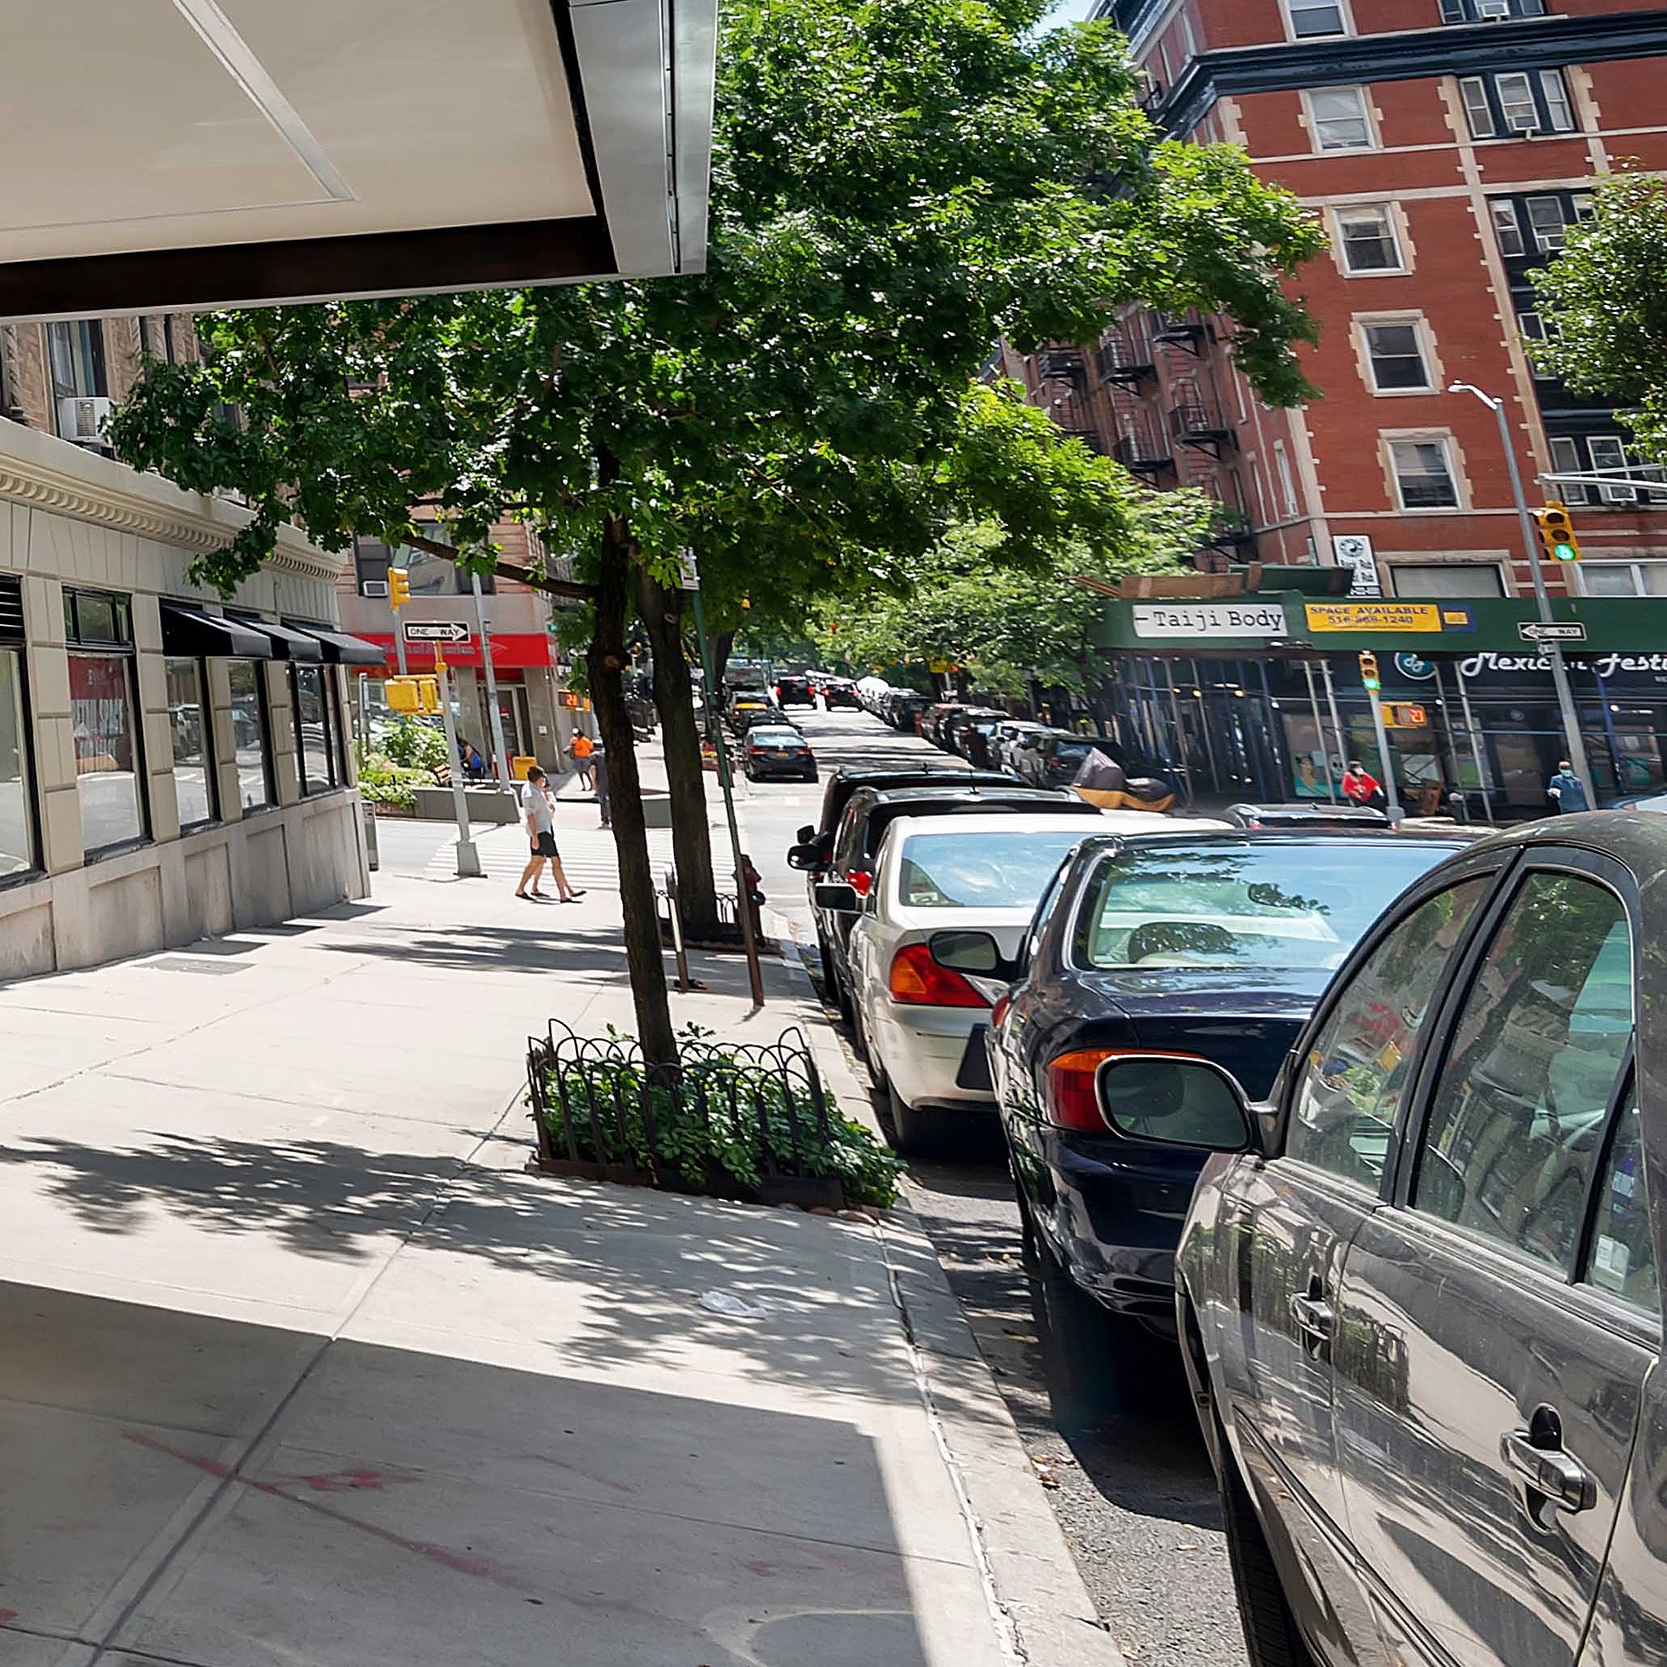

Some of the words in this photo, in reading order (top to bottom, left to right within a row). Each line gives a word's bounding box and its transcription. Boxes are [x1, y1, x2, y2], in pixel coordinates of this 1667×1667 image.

[1310, 607, 1351, 615] SPACE
[1357, 606, 1429, 615] AVAILABLE
[1227, 609, 1282, 632] Body
[410, 628, 429, 636] ONE
[1528, 627, 1548, 636] ONE
